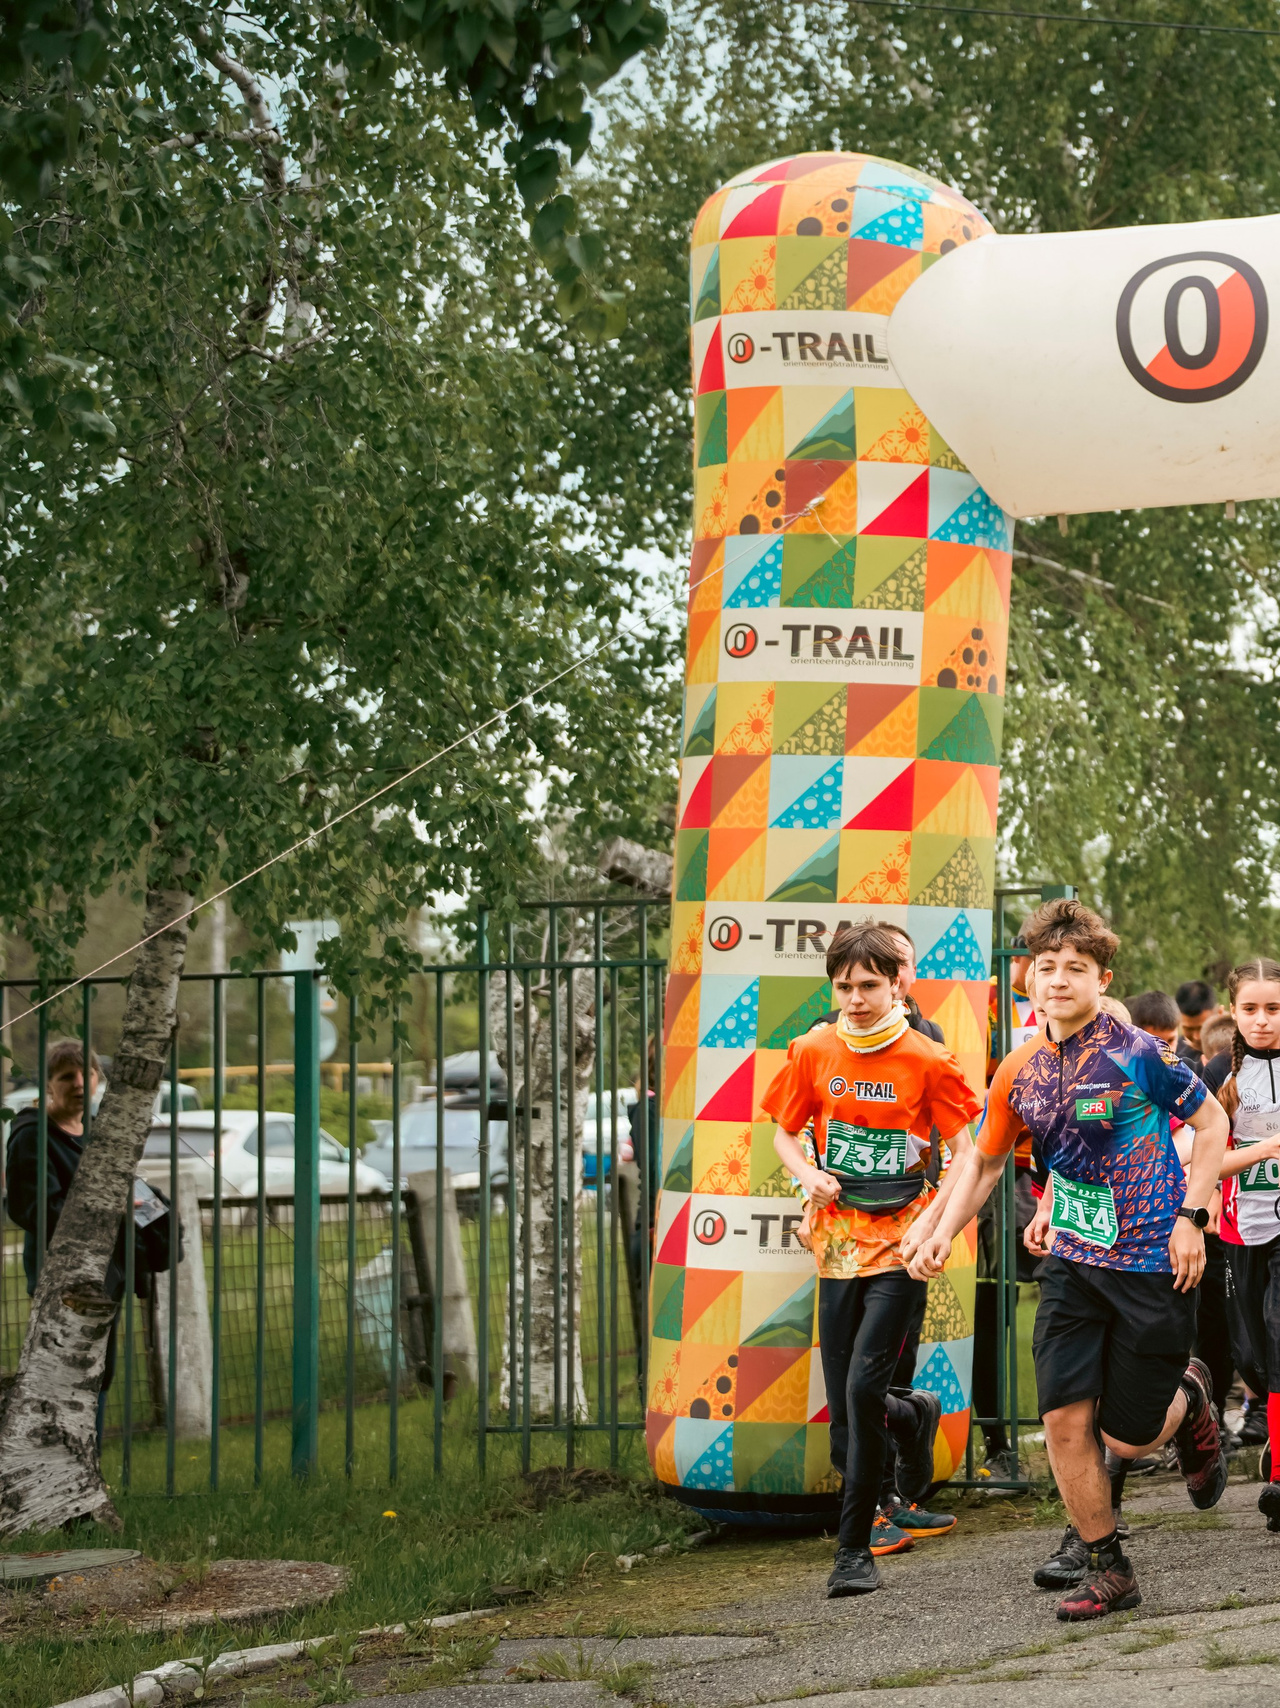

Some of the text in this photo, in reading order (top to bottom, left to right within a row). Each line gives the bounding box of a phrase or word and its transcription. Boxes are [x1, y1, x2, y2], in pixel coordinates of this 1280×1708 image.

[790, 656, 914, 670] orienteering&trailrunning
[1082, 1101, 1104, 1113] SFR
[1265, 1121, 1279, 1131] 86
[831, 1137, 901, 1175] 734
[1058, 1190, 1113, 1237] 714
